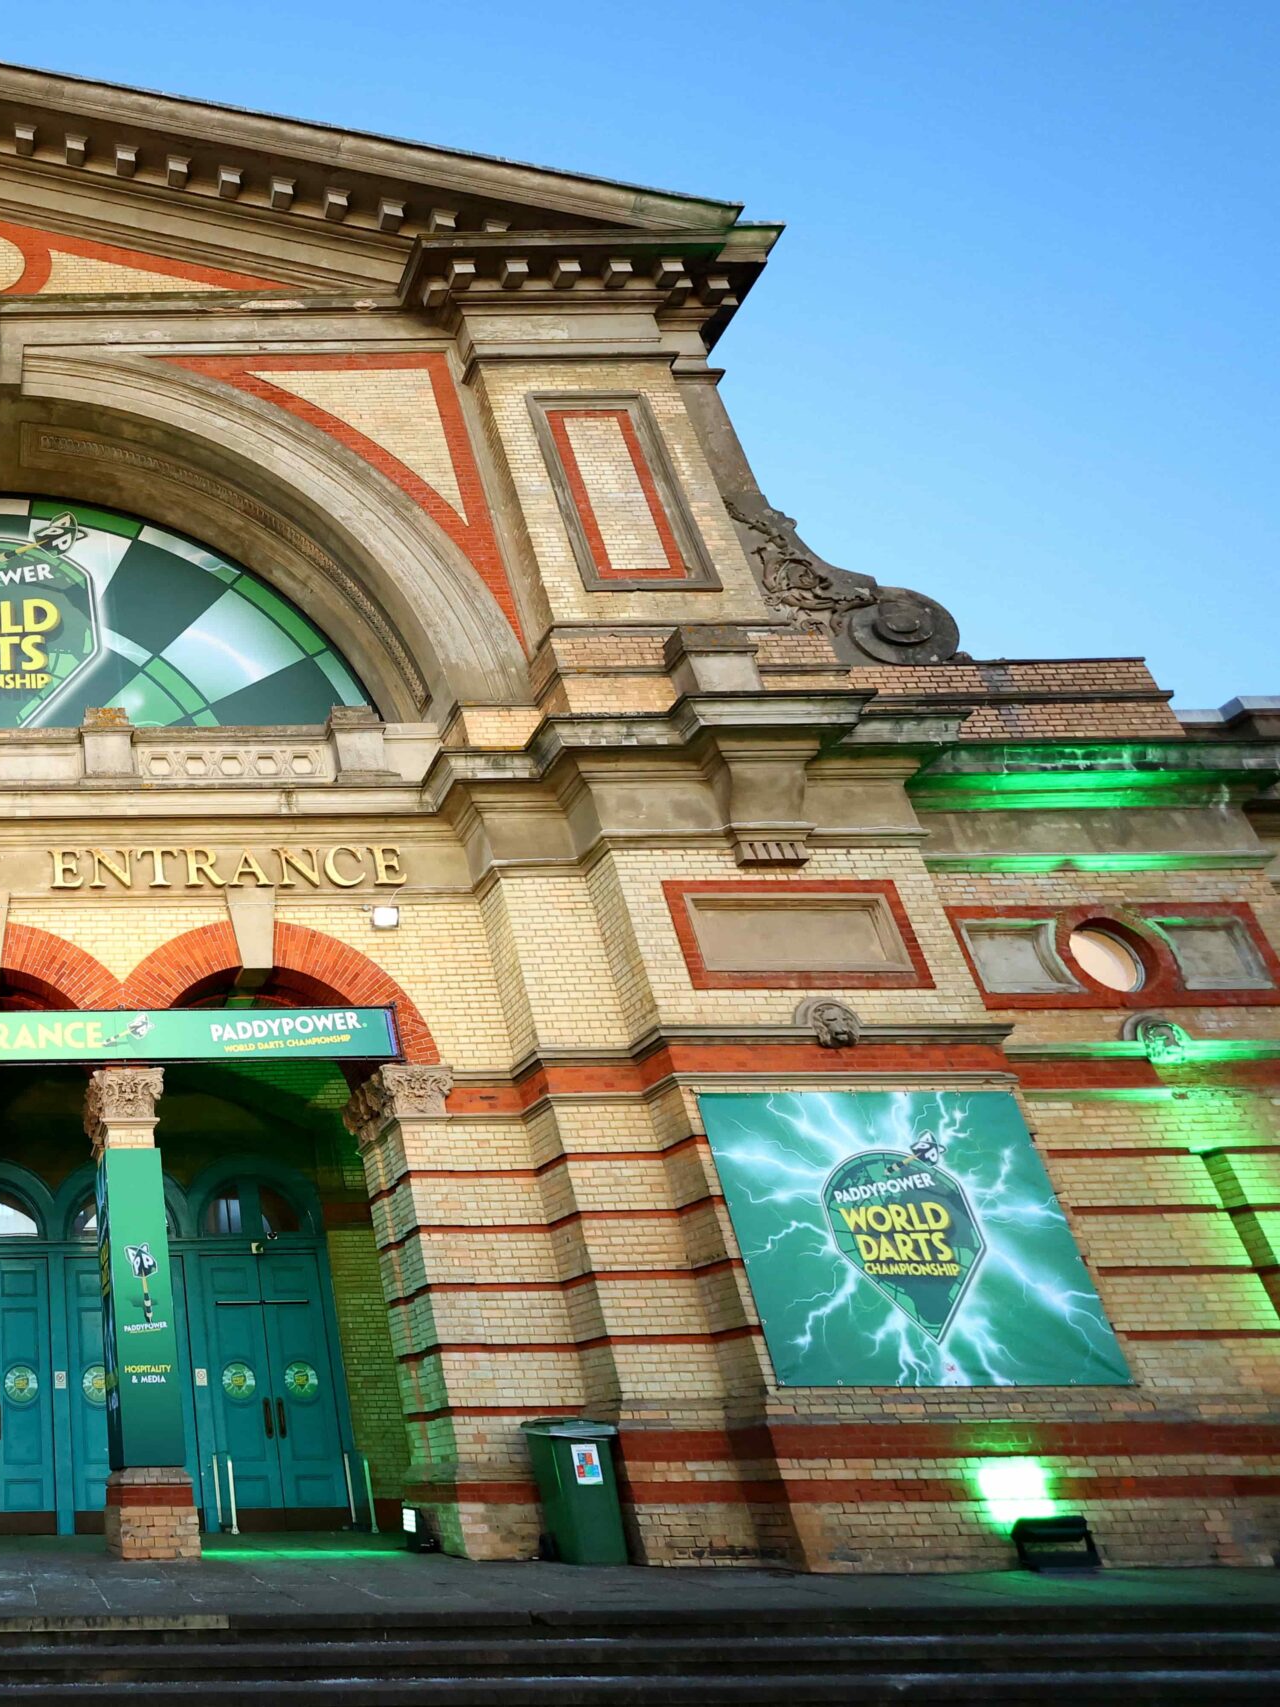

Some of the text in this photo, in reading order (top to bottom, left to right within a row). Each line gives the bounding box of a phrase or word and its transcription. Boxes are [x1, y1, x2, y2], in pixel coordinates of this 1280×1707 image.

[48, 845, 408, 889] ENTRANCE
[223, 1034, 352, 1053] WORLD DARTS CHAMPIONSHIP
[833, 1172, 936, 1204] PADDYPOWER
[838, 1201, 951, 1233] WORLD
[855, 1231, 953, 1261] DARTS
[863, 1262, 961, 1277] CHAMPIONSHIP
[123, 1321, 167, 1332] PADDYPOWER
[124, 1364, 171, 1373] HOSPITALITY
[131, 1375, 166, 1384] & MEDIA
